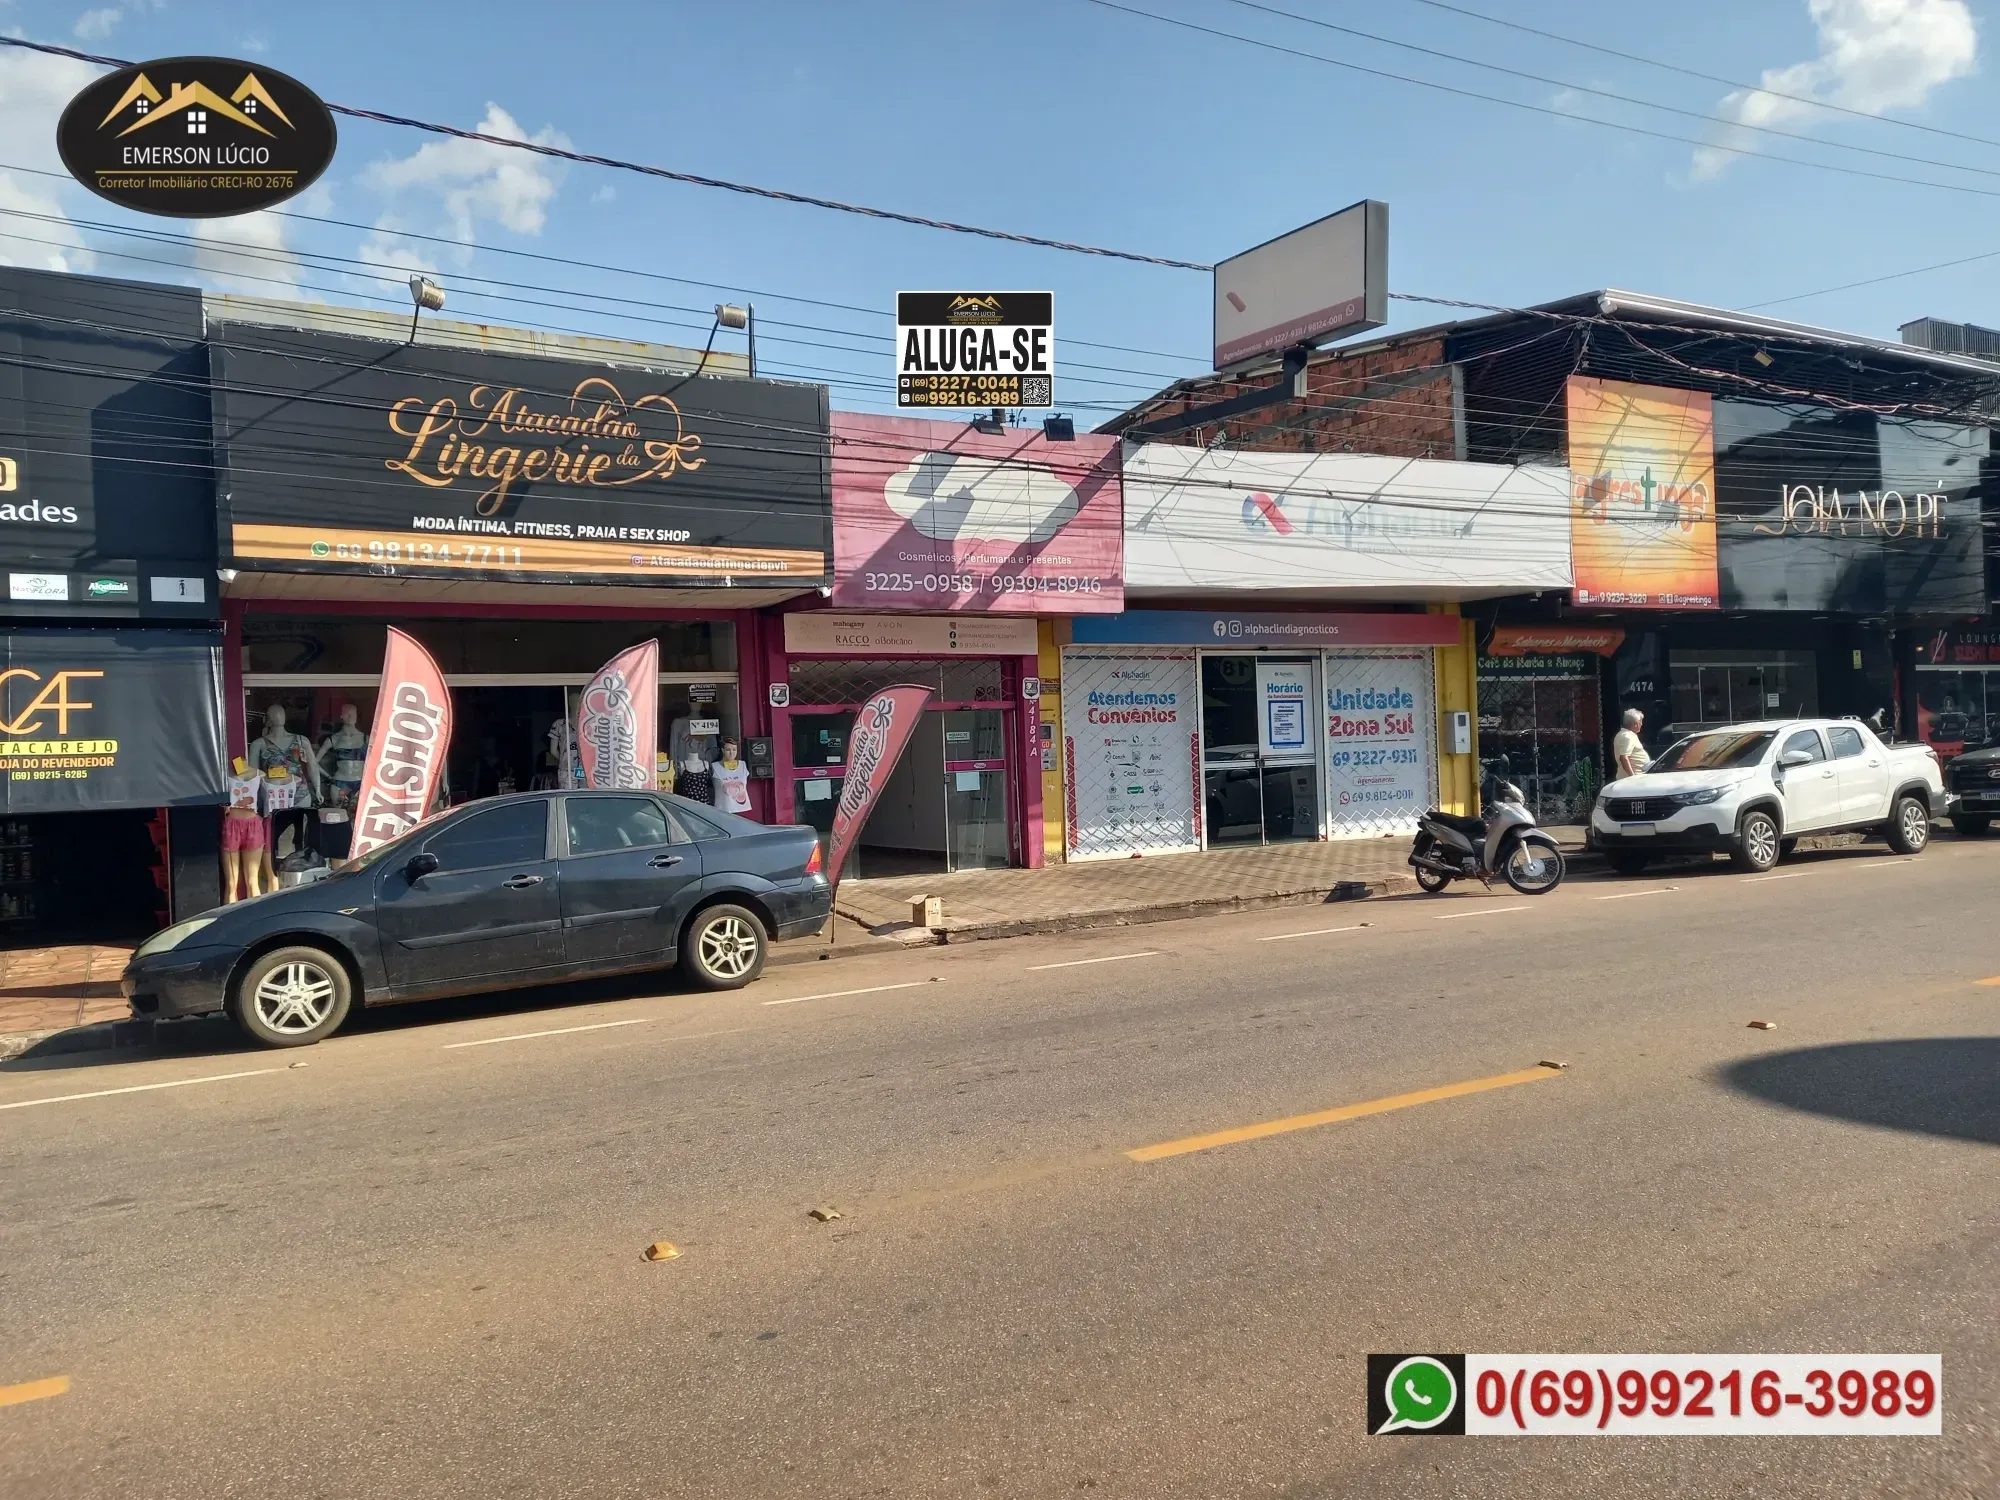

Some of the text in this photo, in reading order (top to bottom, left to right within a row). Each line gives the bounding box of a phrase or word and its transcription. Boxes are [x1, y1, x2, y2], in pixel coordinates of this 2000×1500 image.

[459, 386, 641, 438] Atacadão
[384, 398, 641, 516] Lingerie da
[1858, 490, 1907, 537] NO
[1916, 479, 1949, 540] PÉ
[413, 515, 691, 542] MODA ÍNTIMA, FITNESS, PRAIA E SEX SHOP
[336, 540, 522, 566] 69 98134-7711
[898, 551, 956, 563] Cosméticos
[964, 554, 1017, 565] Perfumaria
[1018, 556, 1024, 565] e
[1026, 554, 1072, 565] Presentes
[865, 572, 1101, 594] 3225-0958 / 99394-8946
[1244, 623, 1339, 637] alphaclindiagnosticos
[1959, 633, 2000, 643] LOUNG
[835, 635, 870, 644] RACCO
[1267, 683, 1304, 693] Horário
[1629, 681, 1654, 692] 4174
[1088, 690, 1176, 706] Atendemos
[1327, 687, 1414, 711] Unidade
[1088, 707, 1177, 724] Convênios
[1328, 713, 1415, 737] Zona Sul
[381, 685, 438, 791] SHOP
[593, 717, 610, 787] Atacadão
[614, 727, 646, 789] ngerie
[1030, 747, 1038, 756] A
[1332, 748, 1418, 767] 69 3227-9311
[22, 758, 39, 769] DO
[41, 757, 114, 769] REVENDEDOR
[11, 770, 88, 780] (69) 99215-6285
[1352, 792, 1364, 803] 69
[1631, 801, 1646, 815] FIAT
[357, 793, 421, 857] EX
